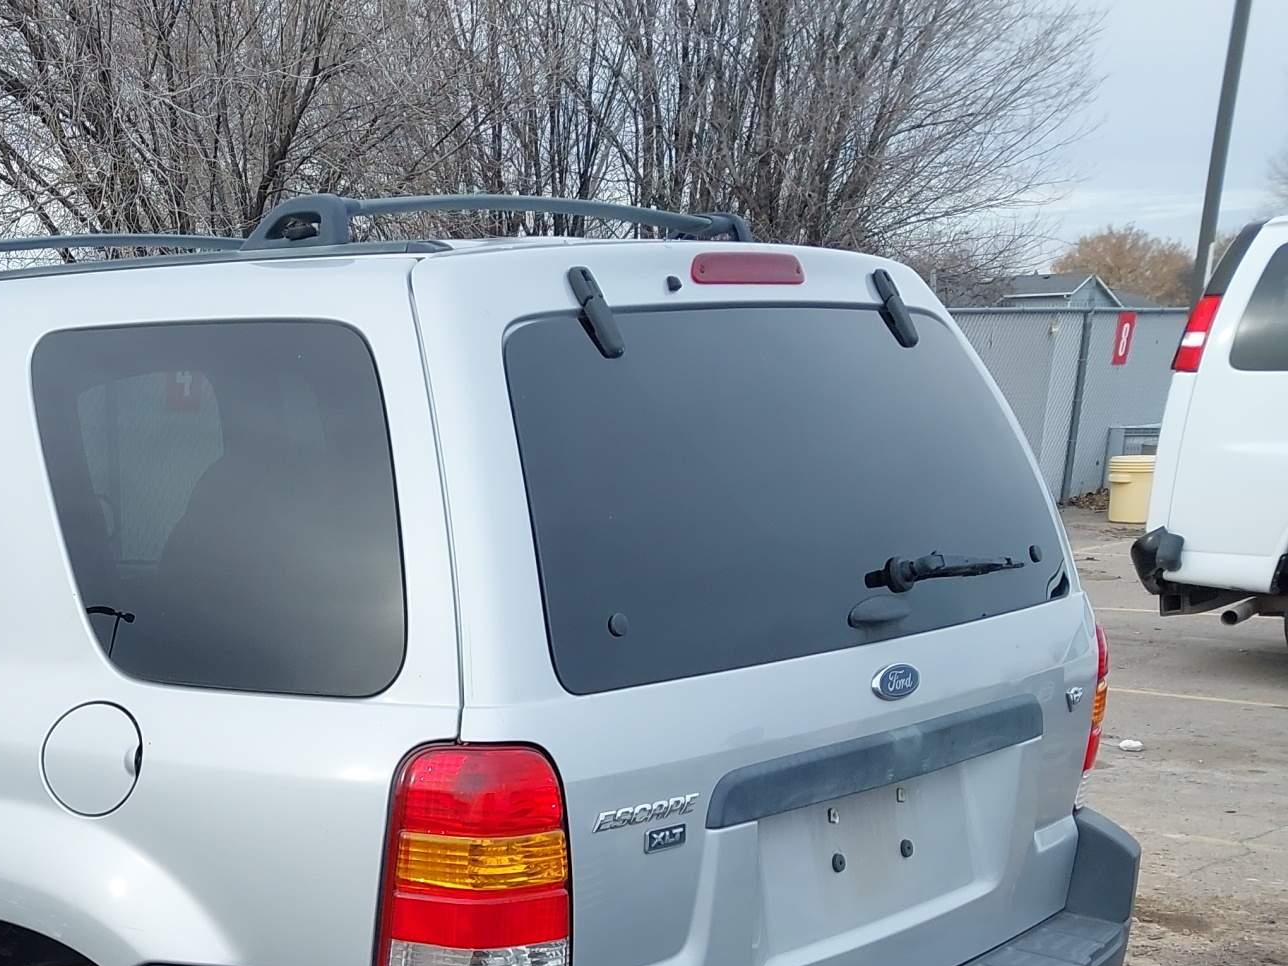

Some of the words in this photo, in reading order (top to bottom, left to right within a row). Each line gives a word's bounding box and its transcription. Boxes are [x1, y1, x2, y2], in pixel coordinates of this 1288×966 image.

[1118, 322, 1130, 357] 8
[592, 792, 700, 833] ESCAPE
[650, 827, 684, 848] XLT
